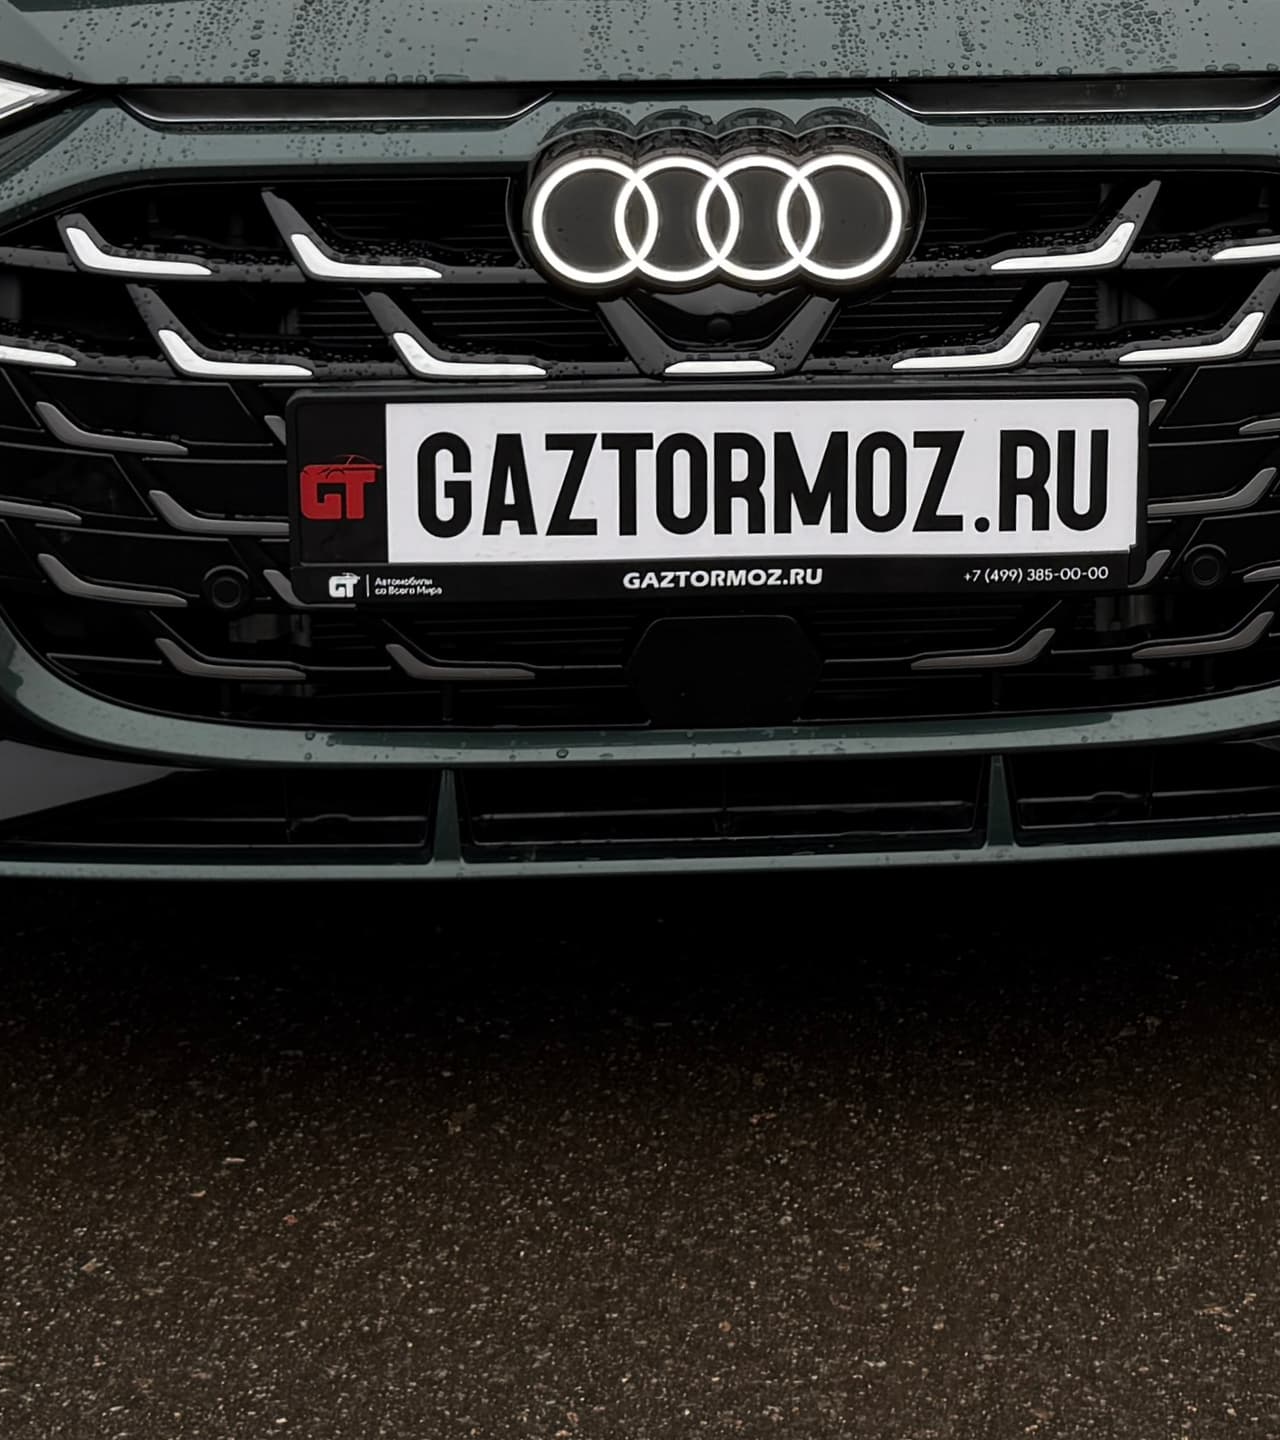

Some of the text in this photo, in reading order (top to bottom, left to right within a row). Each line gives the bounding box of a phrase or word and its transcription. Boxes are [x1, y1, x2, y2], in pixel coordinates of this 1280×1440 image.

[300, 462, 381, 520] GT
[417, 429, 1109, 538] GAZTORMOZ.RU
[328, 573, 361, 598] GT
[622, 567, 823, 590] GAZTORMOZ.RU
[963, 566, 1109, 584] +7 (499) 385-00-00
